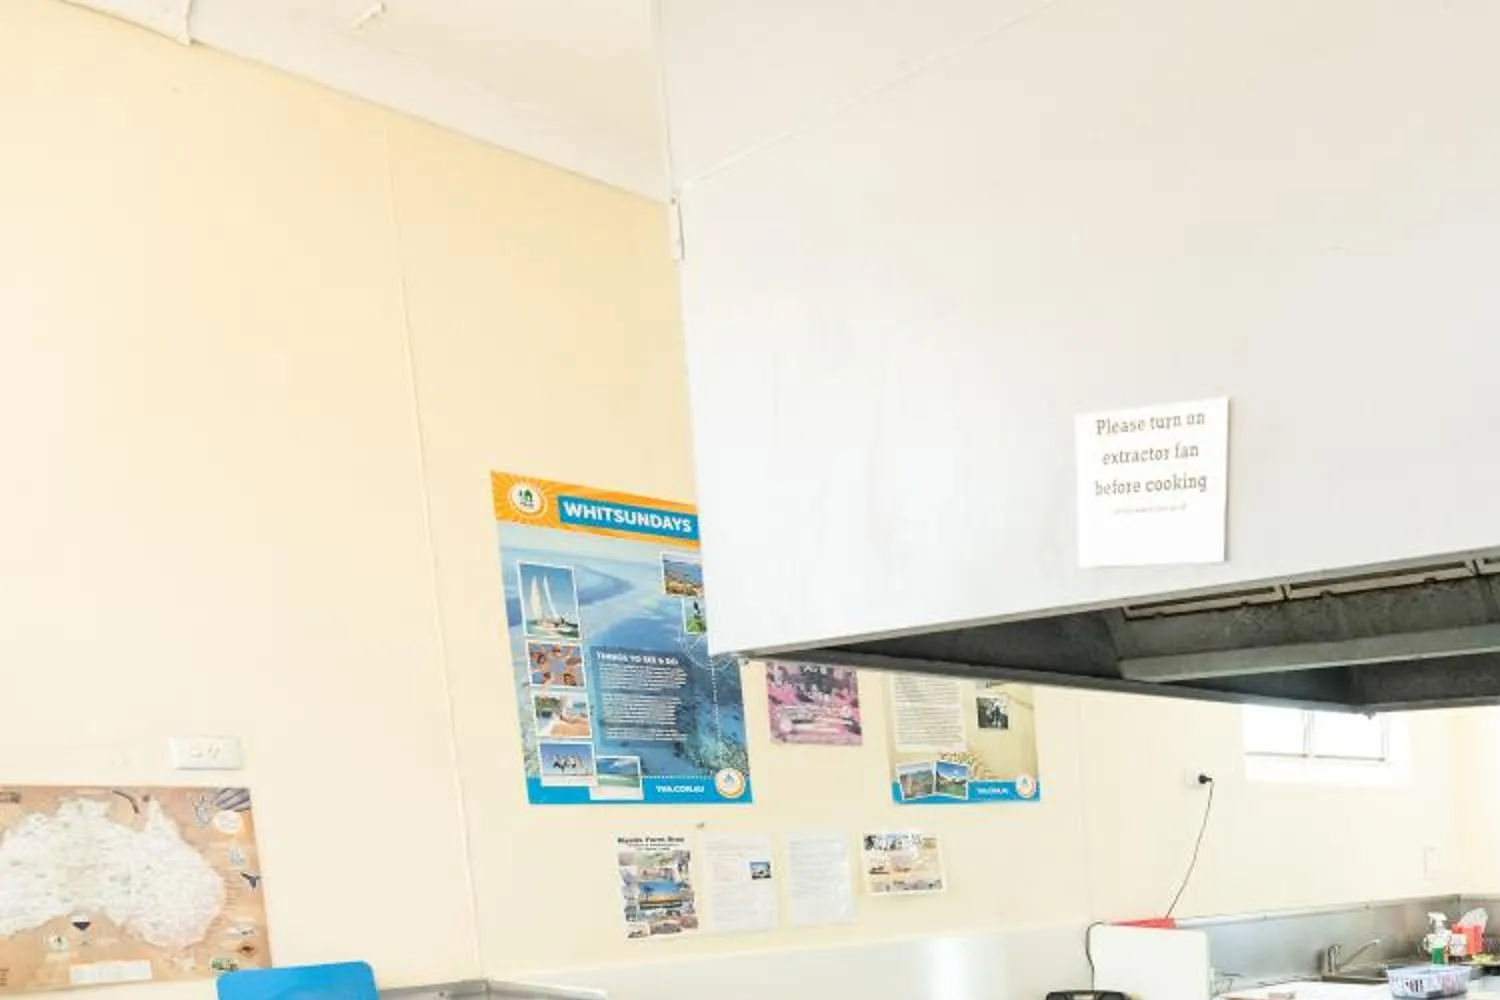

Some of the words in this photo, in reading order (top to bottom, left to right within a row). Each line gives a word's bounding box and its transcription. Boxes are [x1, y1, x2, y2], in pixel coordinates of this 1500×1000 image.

[1096, 417, 1146, 436] Please
[1149, 413, 1182, 431] turn
[1186, 412, 1206, 427] on
[1101, 446, 1171, 466] extractor
[1174, 442, 1199, 459] fan
[1095, 478, 1141, 497] before
[1145, 473, 1207, 492] cooking
[563, 501, 692, 532] WHITSUNDAYS
